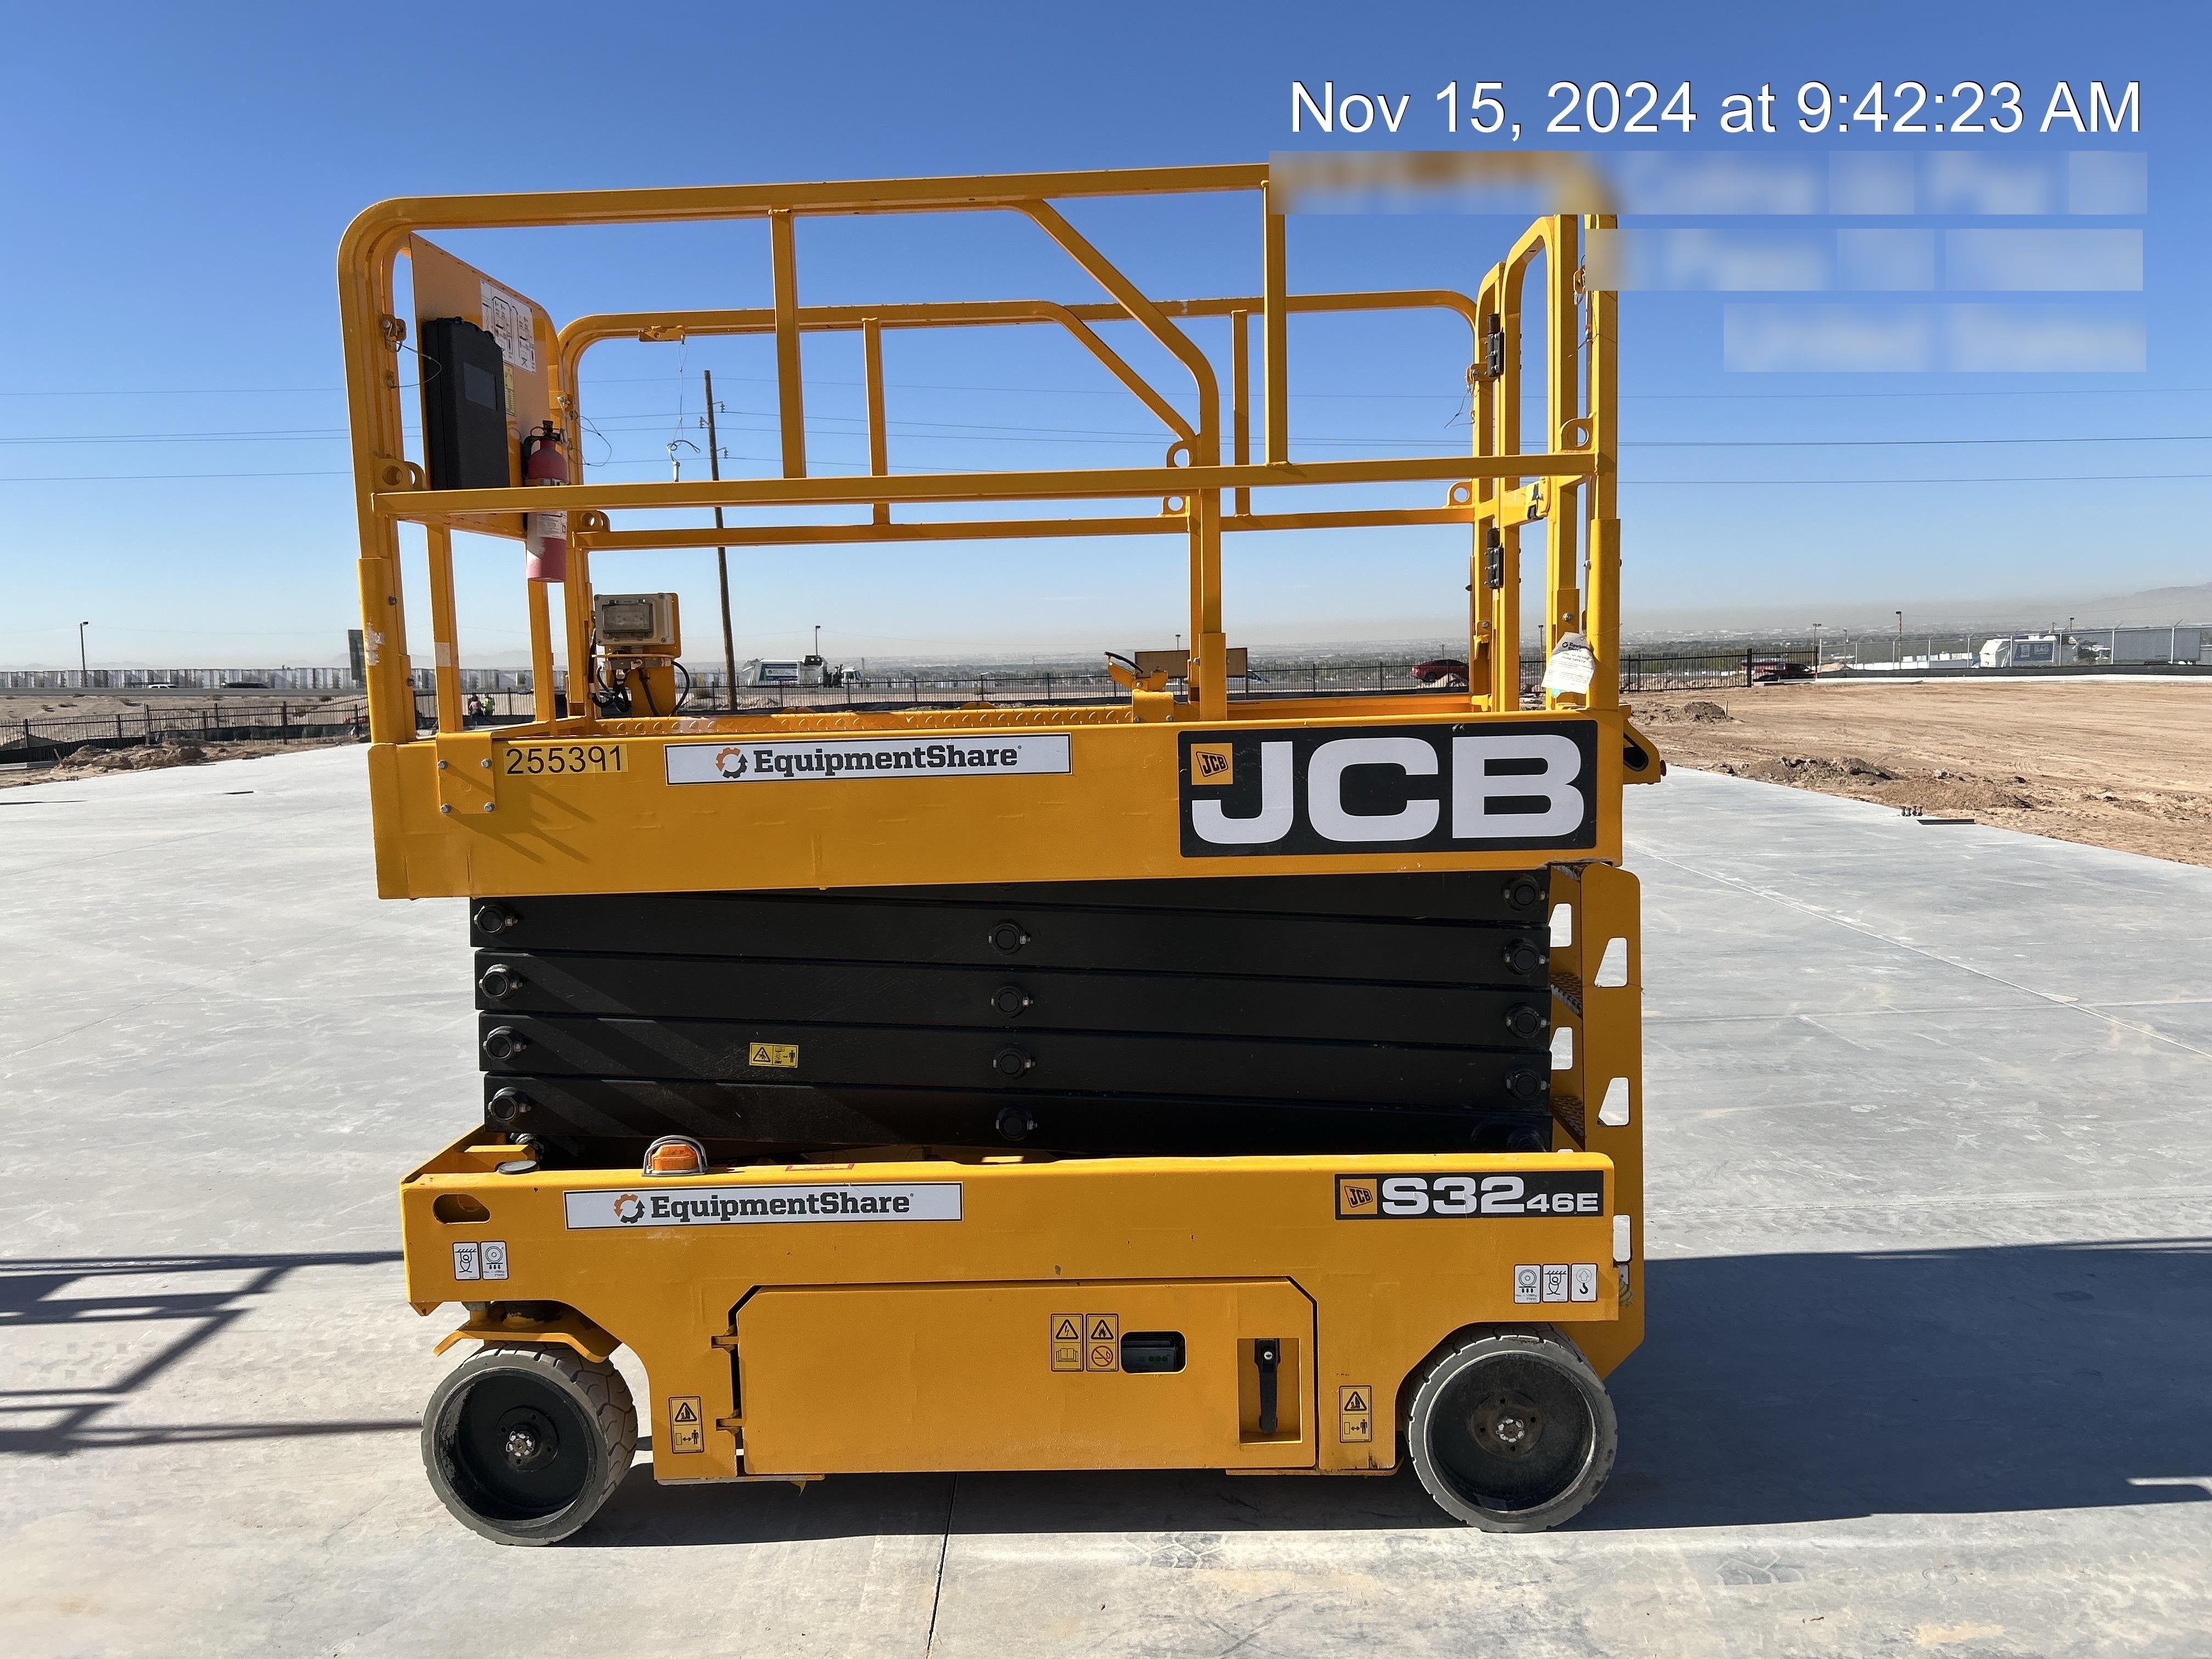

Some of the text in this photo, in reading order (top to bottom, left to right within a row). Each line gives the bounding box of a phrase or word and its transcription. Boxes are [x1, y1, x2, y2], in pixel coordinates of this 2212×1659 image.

[506, 745, 621, 775] 255391
[754, 744, 1019, 777] EquipmentShare
[1201, 754, 1227, 774] JCB
[1192, 734, 1584, 844] JCB
[651, 1192, 910, 1222] EquipmentShare
[1349, 1188, 1371, 1205] JCB
